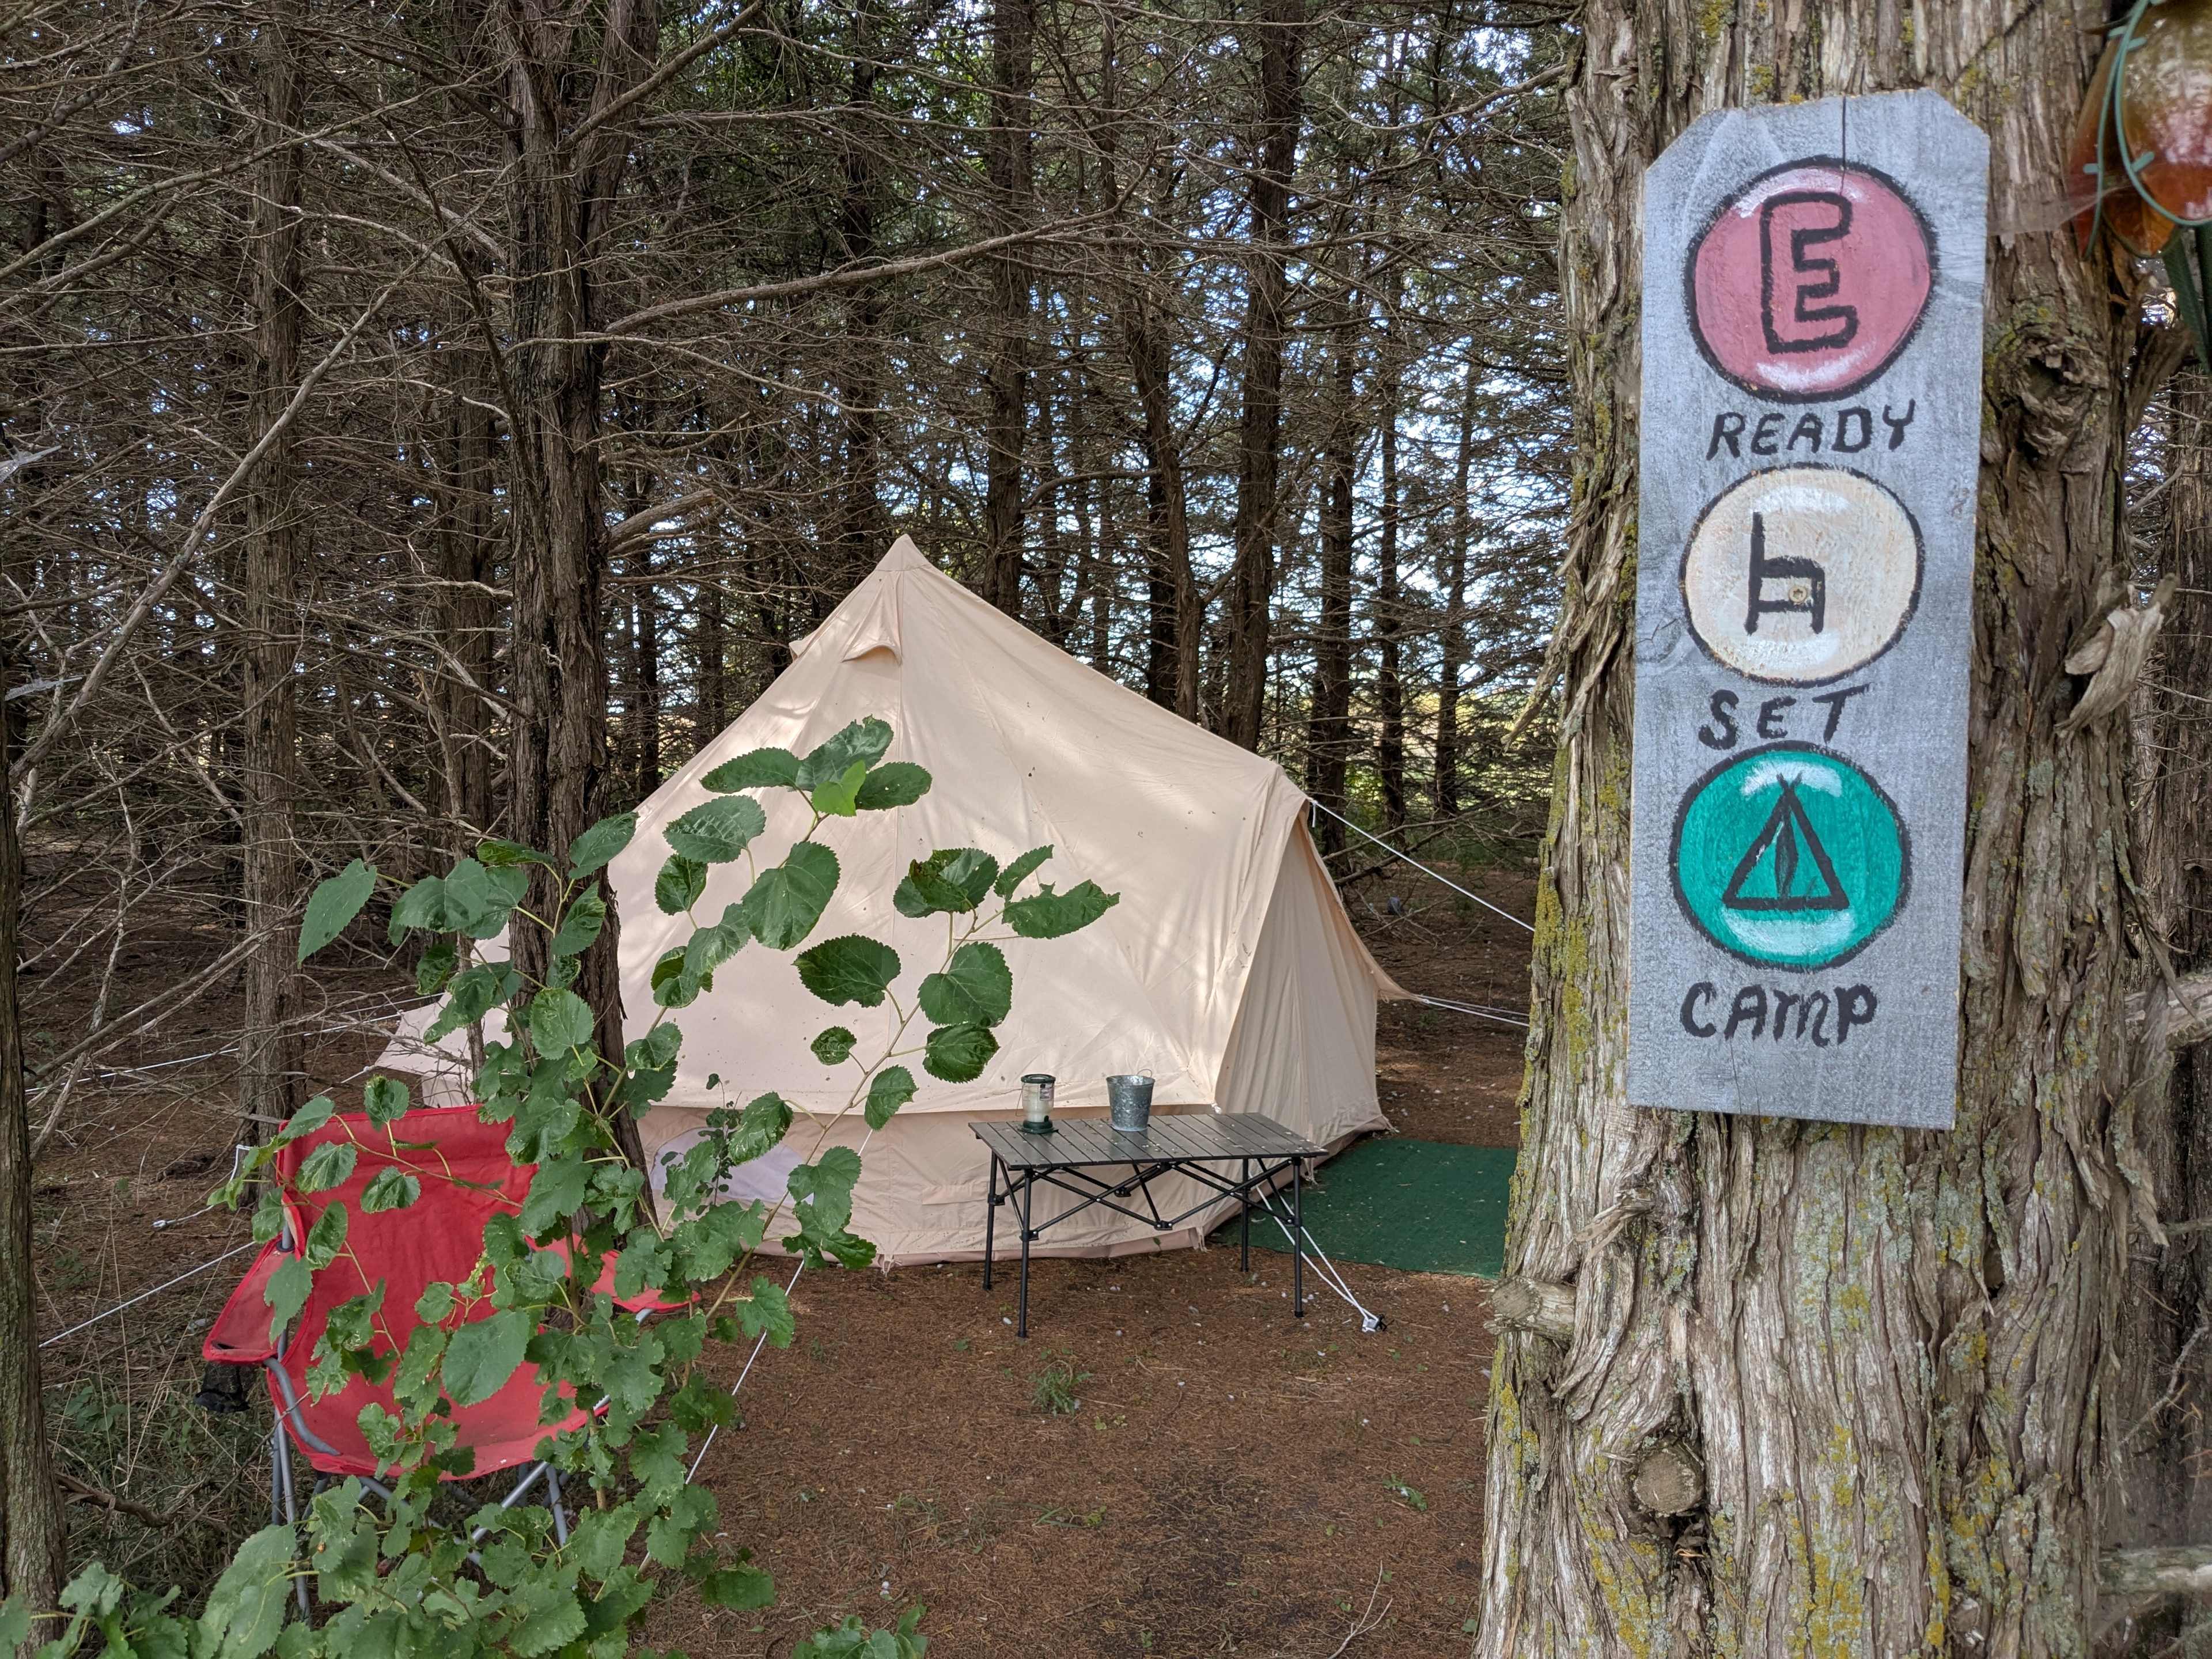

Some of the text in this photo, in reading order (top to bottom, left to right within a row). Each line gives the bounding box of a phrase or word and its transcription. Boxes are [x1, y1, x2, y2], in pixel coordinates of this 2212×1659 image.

[1760, 191, 1861, 354] E
[1706, 399, 1916, 460] READY
[1698, 684, 1870, 750] SET
